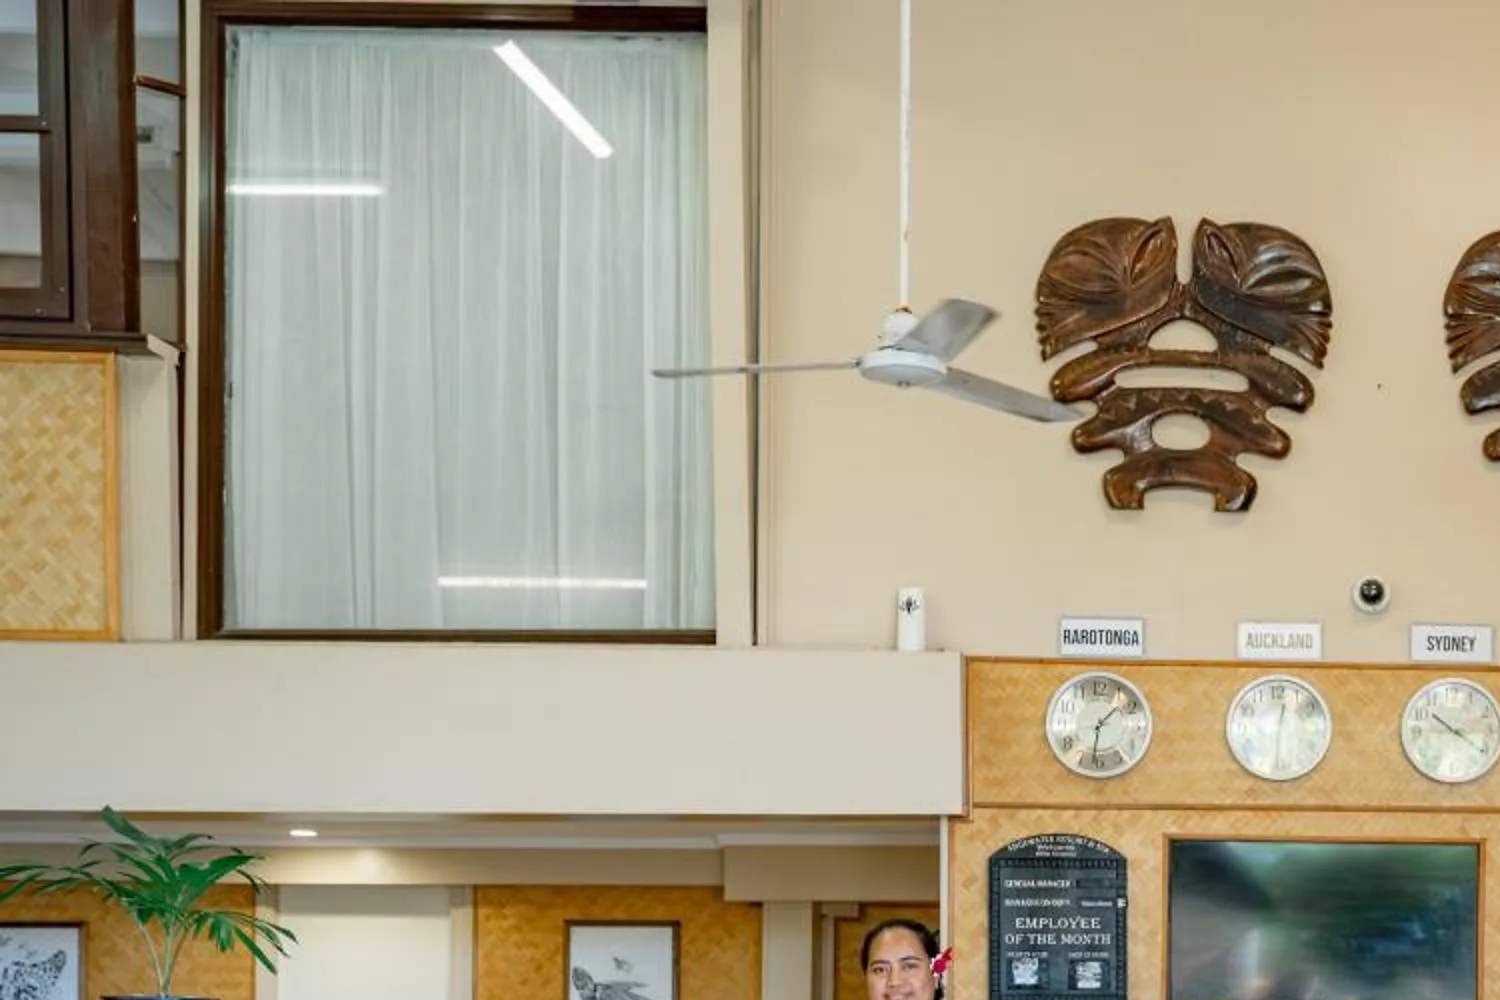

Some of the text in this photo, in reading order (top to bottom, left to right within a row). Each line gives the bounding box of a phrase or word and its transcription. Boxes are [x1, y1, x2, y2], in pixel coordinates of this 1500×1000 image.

[1063, 629, 1139, 646] RAROTONGA
[1246, 632, 1313, 650] AUCKLAND
[1426, 635, 1477, 652] SYDNEY
[1093, 680, 1107, 697] 12
[1268, 685, 1285, 700] 12
[1015, 916, 1102, 929] EMPLOYEE
[1005, 934, 1111, 945] OF THE MONTH
